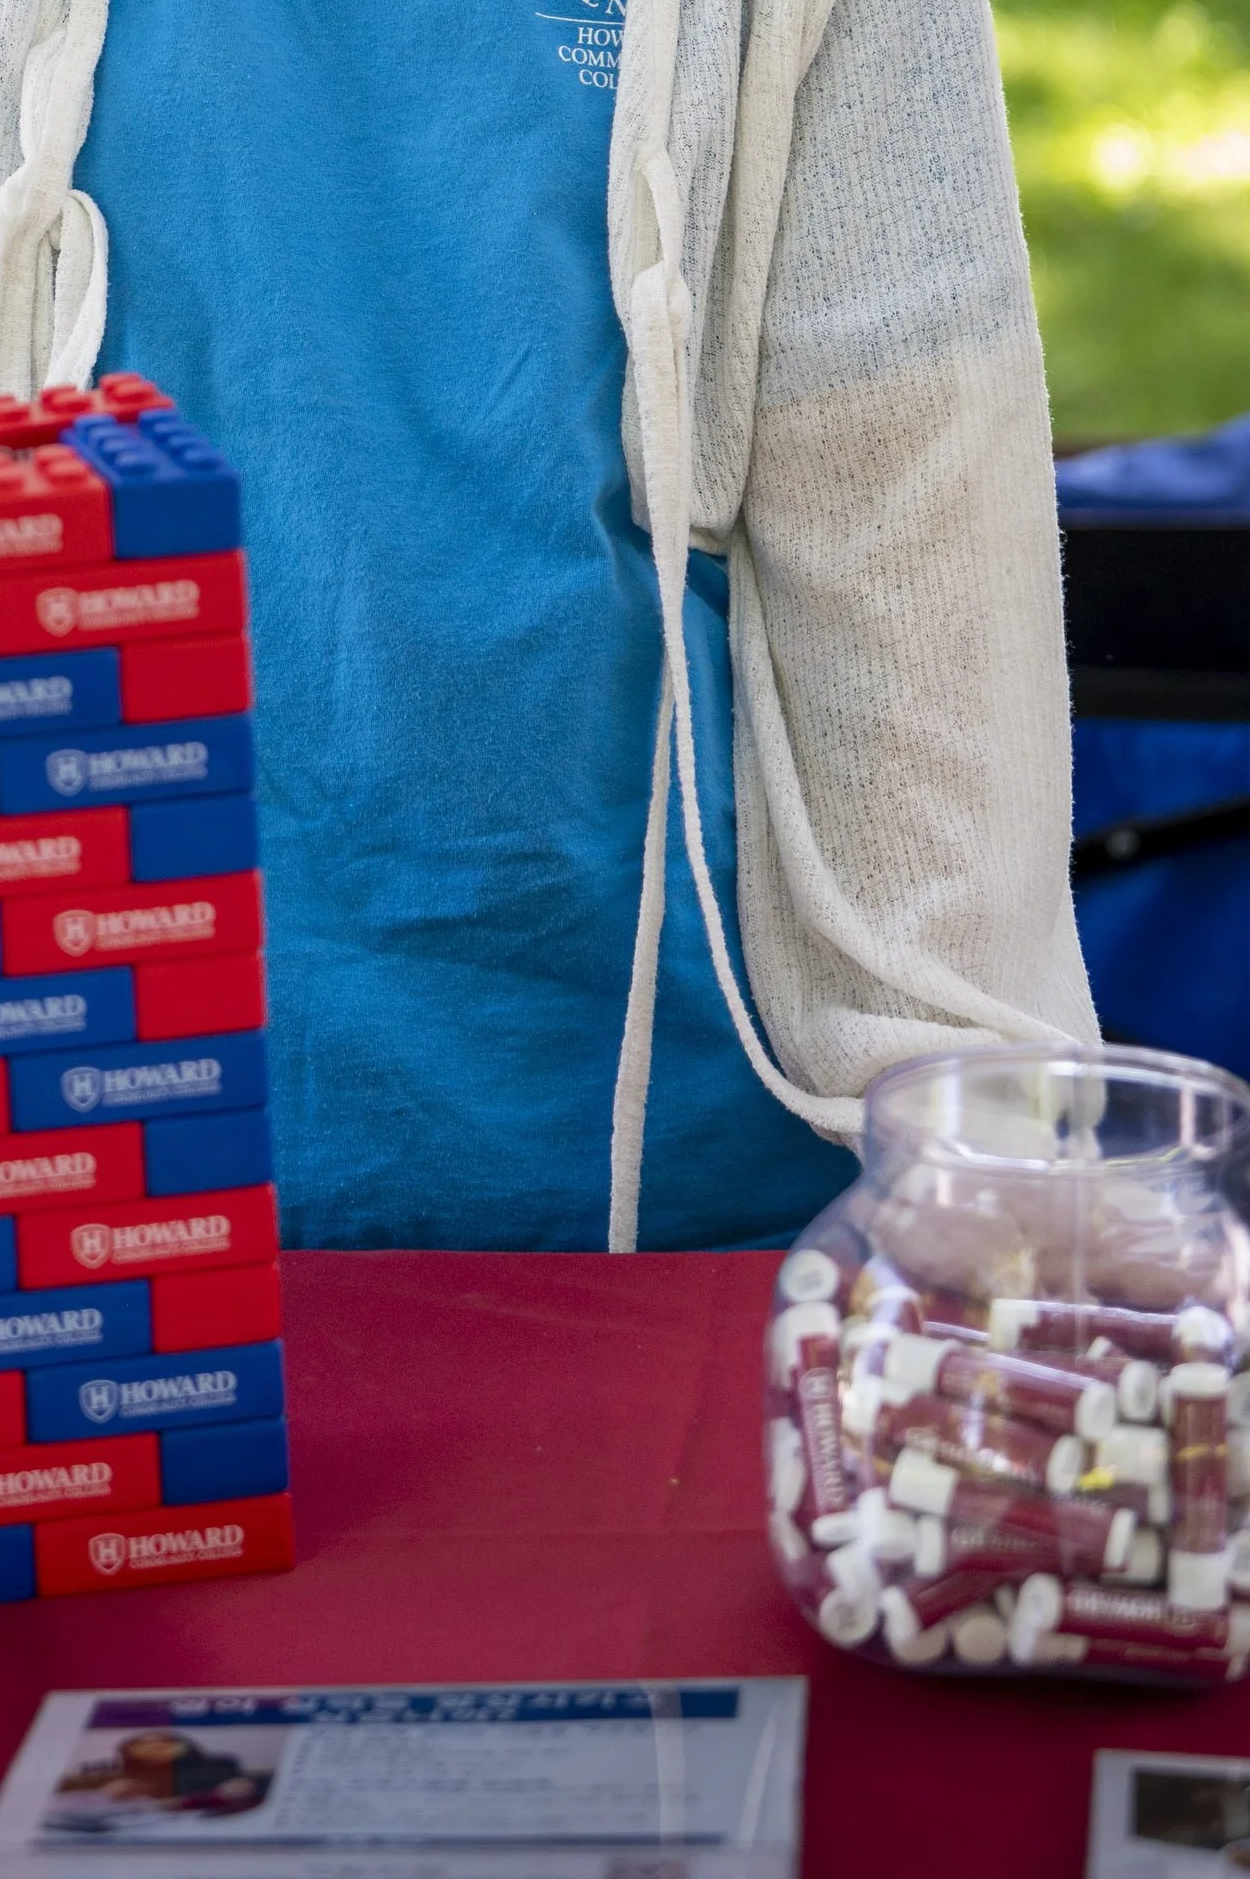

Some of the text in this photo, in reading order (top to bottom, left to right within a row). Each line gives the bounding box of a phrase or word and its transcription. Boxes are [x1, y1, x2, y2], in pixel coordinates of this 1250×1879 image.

[98, 901, 216, 935] HOWARD
[105, 1058, 221, 1092] HOWARD
[113, 1215, 231, 1248] HOWARD
[122, 1370, 237, 1404] HOWARD
[129, 1524, 244, 1558] HOWARD
